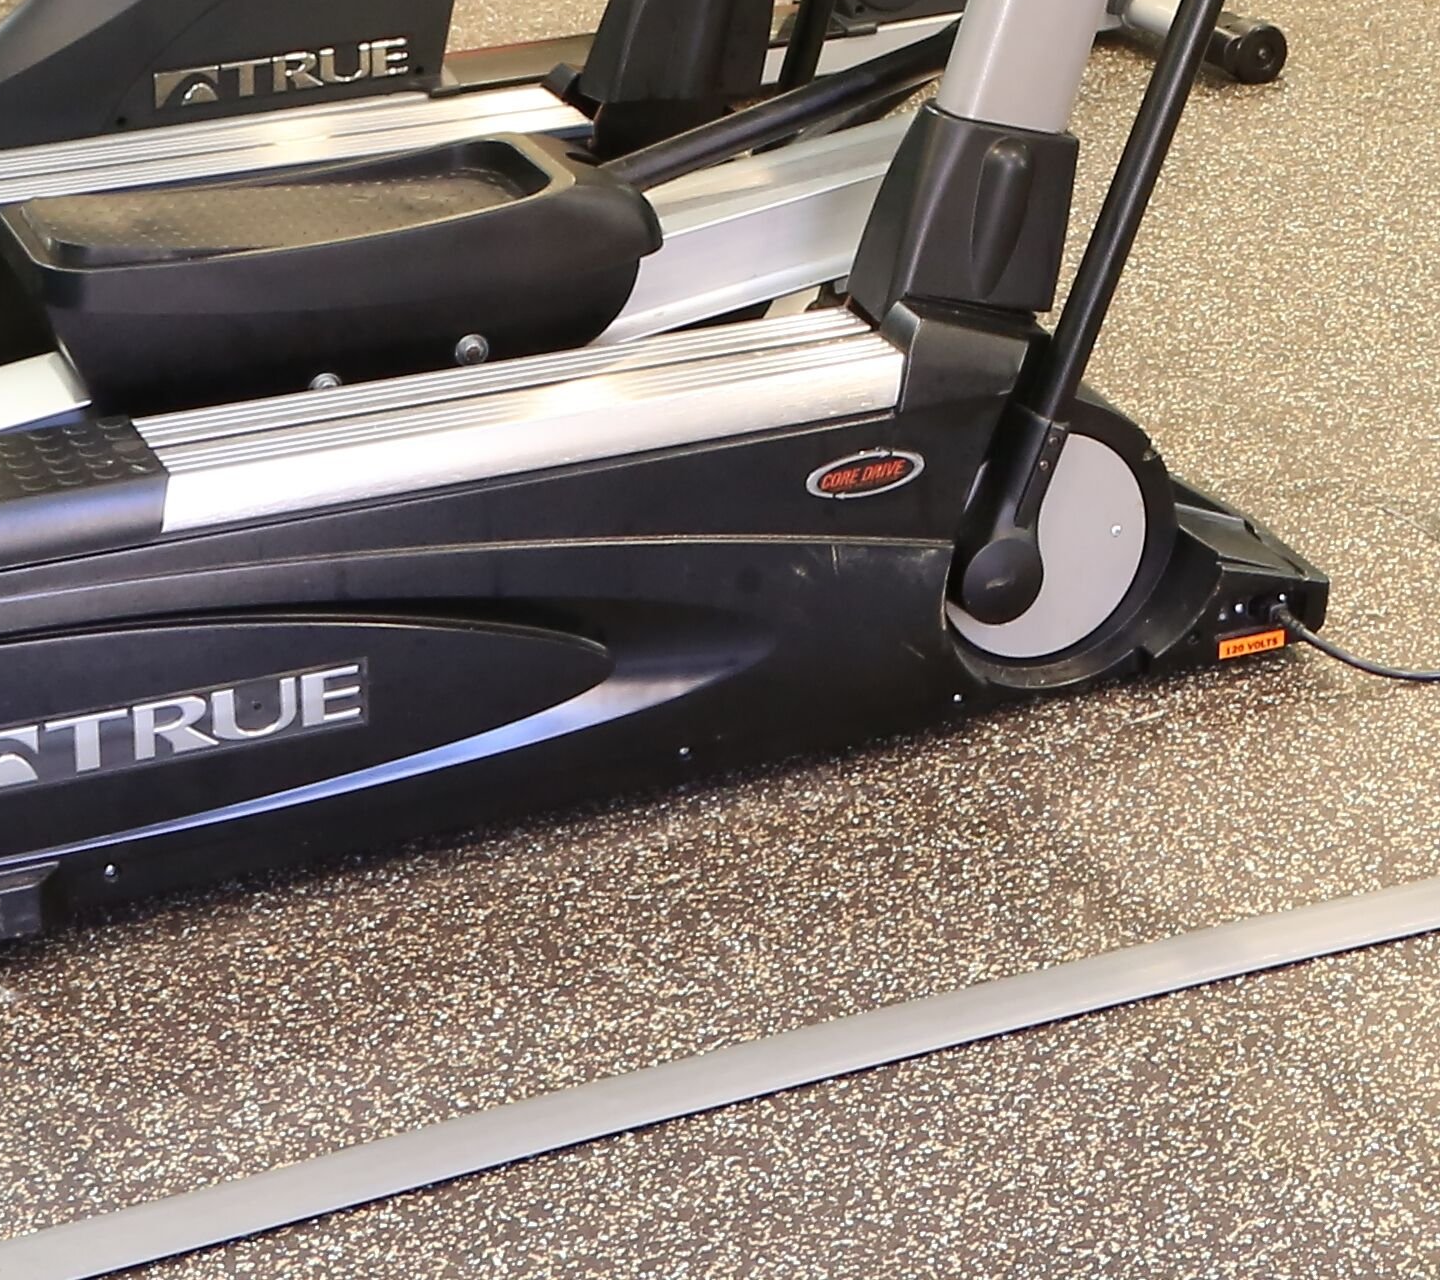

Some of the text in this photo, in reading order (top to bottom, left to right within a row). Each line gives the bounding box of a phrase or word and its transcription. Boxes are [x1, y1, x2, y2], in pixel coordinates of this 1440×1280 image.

[220, 37, 409, 97] TRUE
[820, 458, 907, 489] CORE DRIVE
[1226, 637, 1278, 655] 120 VOLTS
[44, 664, 362, 774] TRUE
